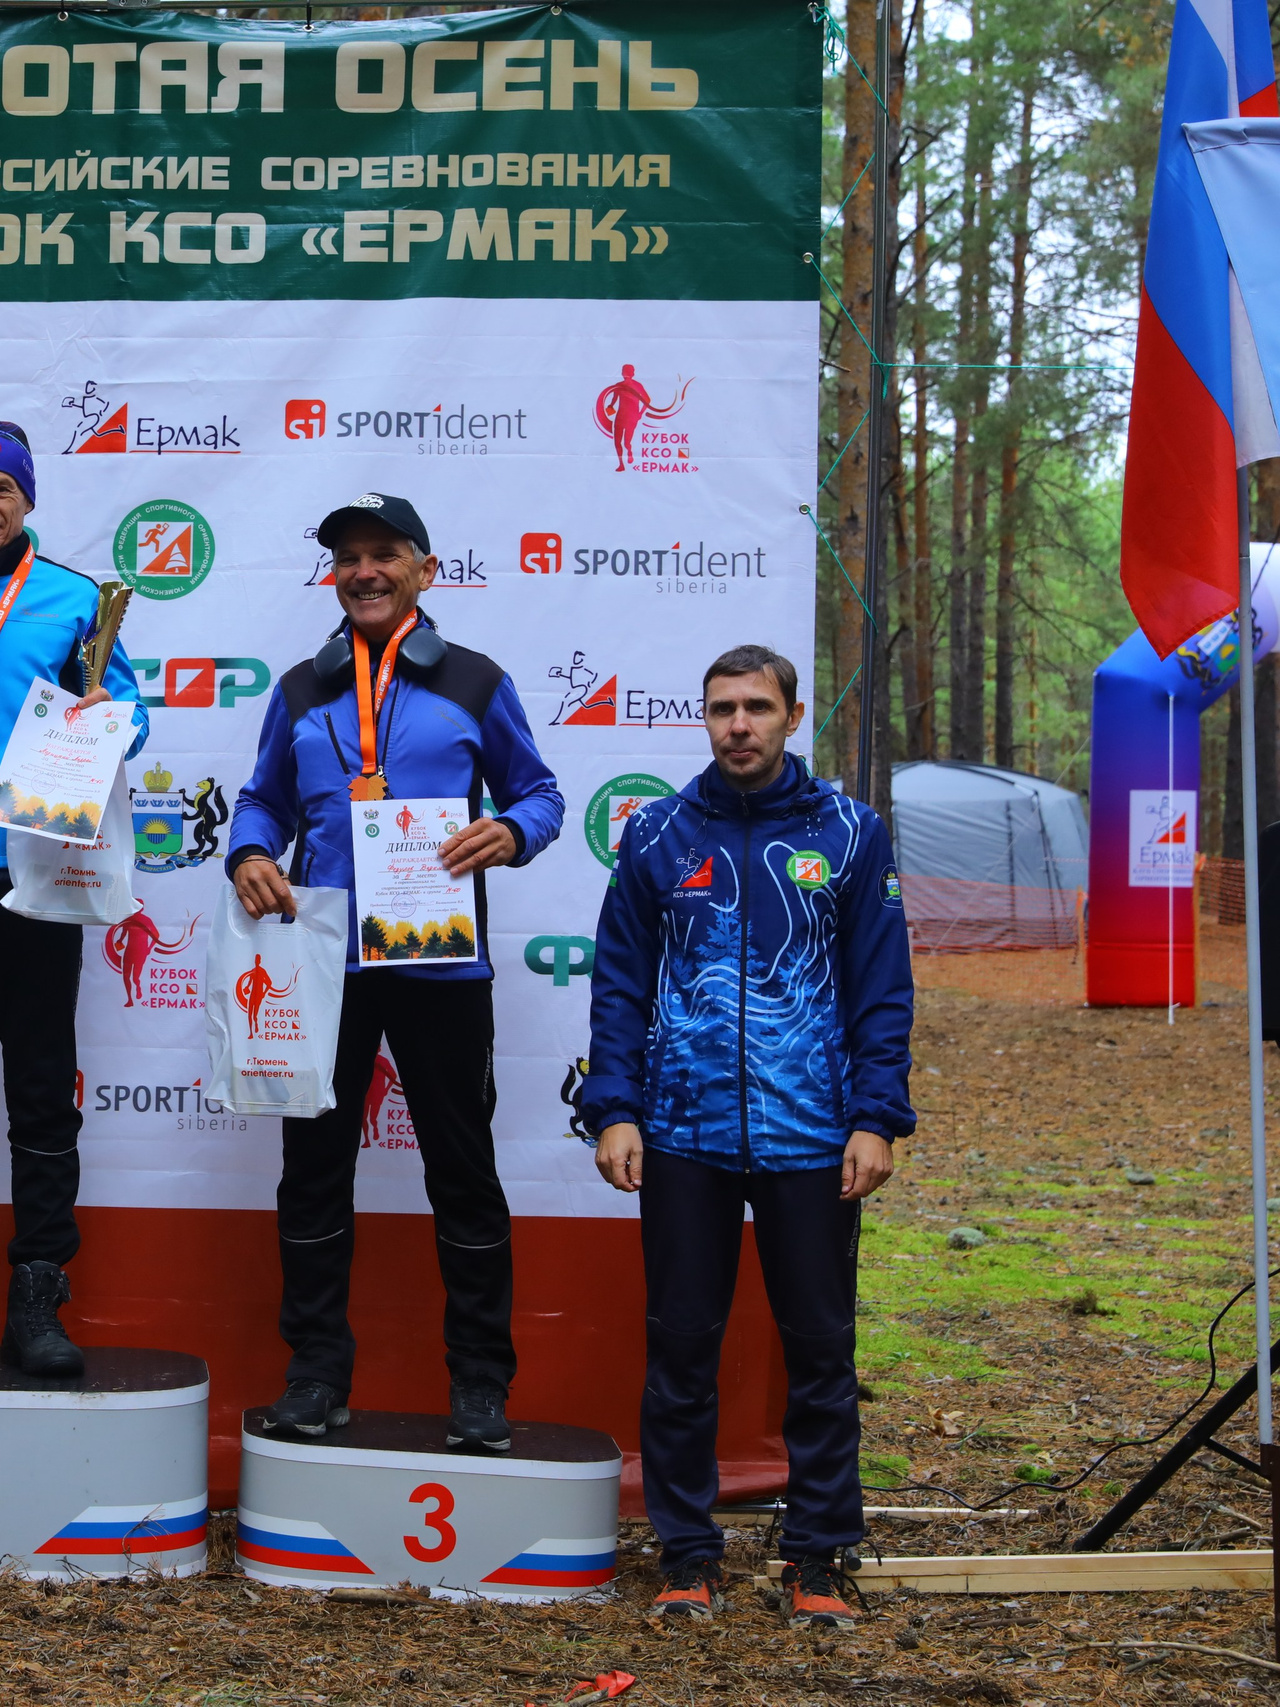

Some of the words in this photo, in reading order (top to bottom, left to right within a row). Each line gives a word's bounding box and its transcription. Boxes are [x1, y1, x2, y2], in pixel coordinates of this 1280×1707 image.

[334, 40, 699, 113] ОСЕНЬ
[260, 154, 672, 190] СОРЕВНОВАНИЯ
[109, 210, 268, 264] КСО
[301, 208, 670, 264] «ЕРМАК»
[336, 404, 527, 439] SPORTident
[135, 414, 241, 455] Ермак
[641, 433, 689, 444] КУБОК
[418, 440, 488, 456] siberia
[641, 448, 673, 458] КСО
[632, 462, 699, 473] «ЕРМАК»
[118, 512, 141, 550] ФЕДЕРАЦИЯ
[145, 504, 195, 520] СПОРТИВНОГО
[190, 524, 210, 585] ОРИЕНТИРОВАНИЯ
[574, 541, 767, 578] SPORTident
[118, 555, 136, 584] ОБЛАСТИ
[140, 584, 185, 596] ТЮМЕНСКОЙ
[656, 578, 727, 594] siberia
[43, 728, 99, 746] ДИПЛОМ
[589, 786, 614, 825] ФЕДЕРАЦИЯ
[617, 778, 668, 795] СПОРТИВНОГО
[385, 841, 441, 854] ДИПЛОМ
[150, 969, 197, 979] КУБОК
[150, 984, 180, 994] КСО
[141, 998, 205, 1009] «ЕРМАК»
[264, 1009, 300, 1018] КУБОК
[264, 1021, 288, 1029] КСО
[258, 1032, 307, 1041] «ЕРМАК»
[247, 1058, 288, 1067] г.Тюмень
[241, 1068, 294, 1079] orienteer.ru
[177, 1115, 247, 1131] siberia
[403, 1482, 457, 1563] 3
